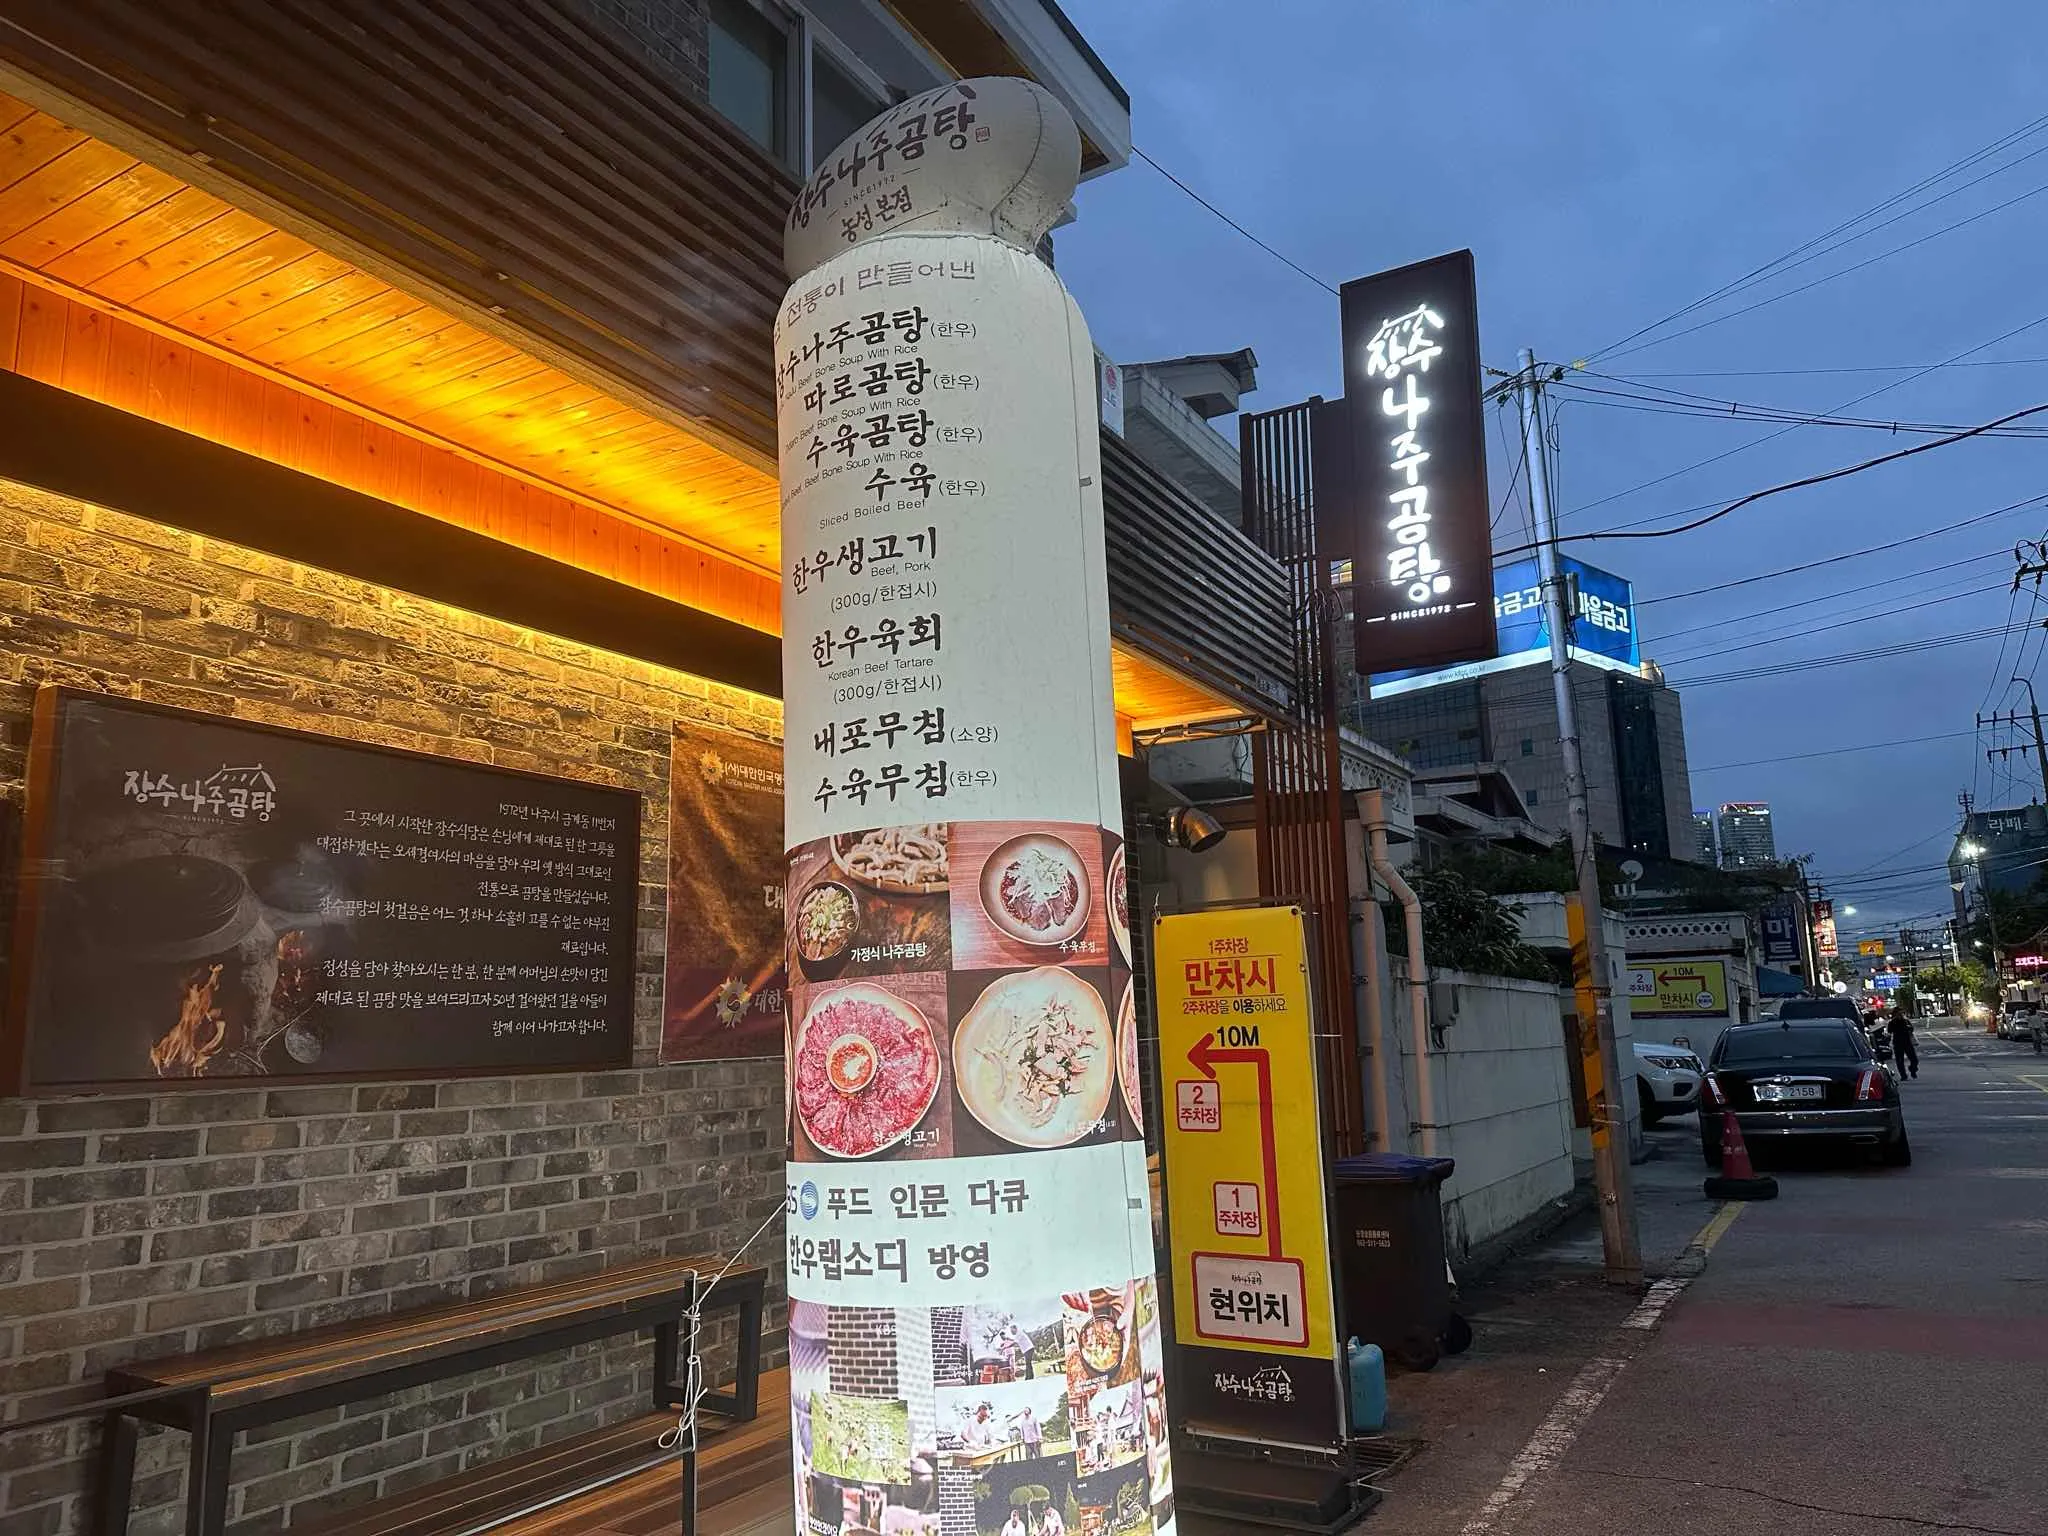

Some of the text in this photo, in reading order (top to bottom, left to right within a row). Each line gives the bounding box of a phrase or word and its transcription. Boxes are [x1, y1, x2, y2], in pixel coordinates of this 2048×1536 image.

[786, 260, 976, 328] 전통이 만들어낸
[815, 362, 837, 378] Bone
[839, 353, 864, 370] Soup
[867, 345, 890, 360] With
[894, 343, 918, 356] Rice
[816, 414, 838, 430] Bone
[841, 404, 867, 421] Soup
[870, 399, 892, 413] With
[896, 397, 921, 408] Rice
[821, 465, 843, 480] Bone
[845, 456, 871, 472] Soup
[874, 451, 896, 464] With
[900, 449, 924, 460] Rice
[819, 498, 926, 530] Sliced Boiled Beef
[792, 526, 937, 595] 한우생고기
[870, 561, 931, 577] Beef, Pork
[830, 582, 937, 614] (300g/한접시)
[1390, 604, 1452, 621] SINCE1972
[812, 613, 942, 669] 한우육회
[828, 656, 934, 682] Korean Beef Tartare
[833, 674, 942, 705] (300g/한접시)
[725, 761, 784, 786] (사)대한민국명
[123, 769, 277, 823] 장수나주곰탕
[499, 803, 529, 821] 1972년
[531, 807, 559, 823] 나주시
[399, 814, 433, 836] 시작한
[435, 820, 490, 842] 장수식당은
[492, 828, 532, 845] 손님에게
[534, 833, 564, 849] 제대로
[566, 837, 575, 852] 된
[589, 841, 616, 858] 그릇을
[316, 835, 391, 859] 대접하겠다는
[463, 851, 496, 871] 마음을
[497, 855, 519, 872] 담아
[520, 858, 541, 874] 우리
[555, 861, 574, 878] 방식
[576, 864, 612, 881] 그대로인
[477, 880, 611, 906] 전통으로 곰탕을 만들었습니다.
[432, 906, 456, 920] 어느
[471, 907, 494, 922] 하나
[528, 912, 549, 929] 고를
[551, 913, 561, 929] 수
[562, 914, 581, 930] 없는
[560, 940, 609, 957] 재료입니다.
[1208, 937, 1249, 955] 1주차장
[1767, 918, 1797, 960] 마트
[851, 942, 928, 963] 가정식 나주곰탕
[322, 959, 362, 978] 정성을
[363, 960, 389, 978] 담아
[391, 961, 449, 981] 찾아오시는
[451, 963, 463, 980] 한
[482, 963, 494, 981] 한
[495, 964, 517, 981] 분께
[519, 965, 558, 982] 어머님의
[560, 967, 588, 983] 손맛이
[590, 967, 609, 983] 담긴
[1185, 957, 1277, 997] 만차시
[1636, 974, 1644, 984] 2
[1672, 967, 1694, 976] 10M
[315, 989, 354, 1006] 제대로
[356, 990, 370, 1008] 된
[372, 991, 398, 1009] 곰탕
[399, 991, 424, 1009] 맛을
[493, 993, 515, 1009] 50년
[559, 993, 578, 1009] 길을
[579, 993, 607, 1009] 아들이
[1183, 998, 1289, 1016] 2주차장을 이용하세요
[1660, 992, 1694, 1006] 만차시
[492, 1019, 513, 1037] 함께
[515, 1020, 536, 1035] 이어
[538, 1019, 577, 1034] 나가고자
[1216, 1025, 1260, 1047] 10M
[1192, 1085, 1204, 1105] 2
[1180, 1107, 1219, 1124] 주차장
[827, 1188, 873, 1220] 푸드
[889, 1183, 949, 1219] 인문
[968, 1179, 1030, 1214] 다큐
[1231, 1187, 1241, 1208] 1
[1218, 1209, 1258, 1229] 주차장
[788, 1234, 990, 1283] 한우랩소디 방영
[1208, 1286, 1290, 1327] 현위치
[1214, 1372, 1293, 1402] 장수나주곰탕
